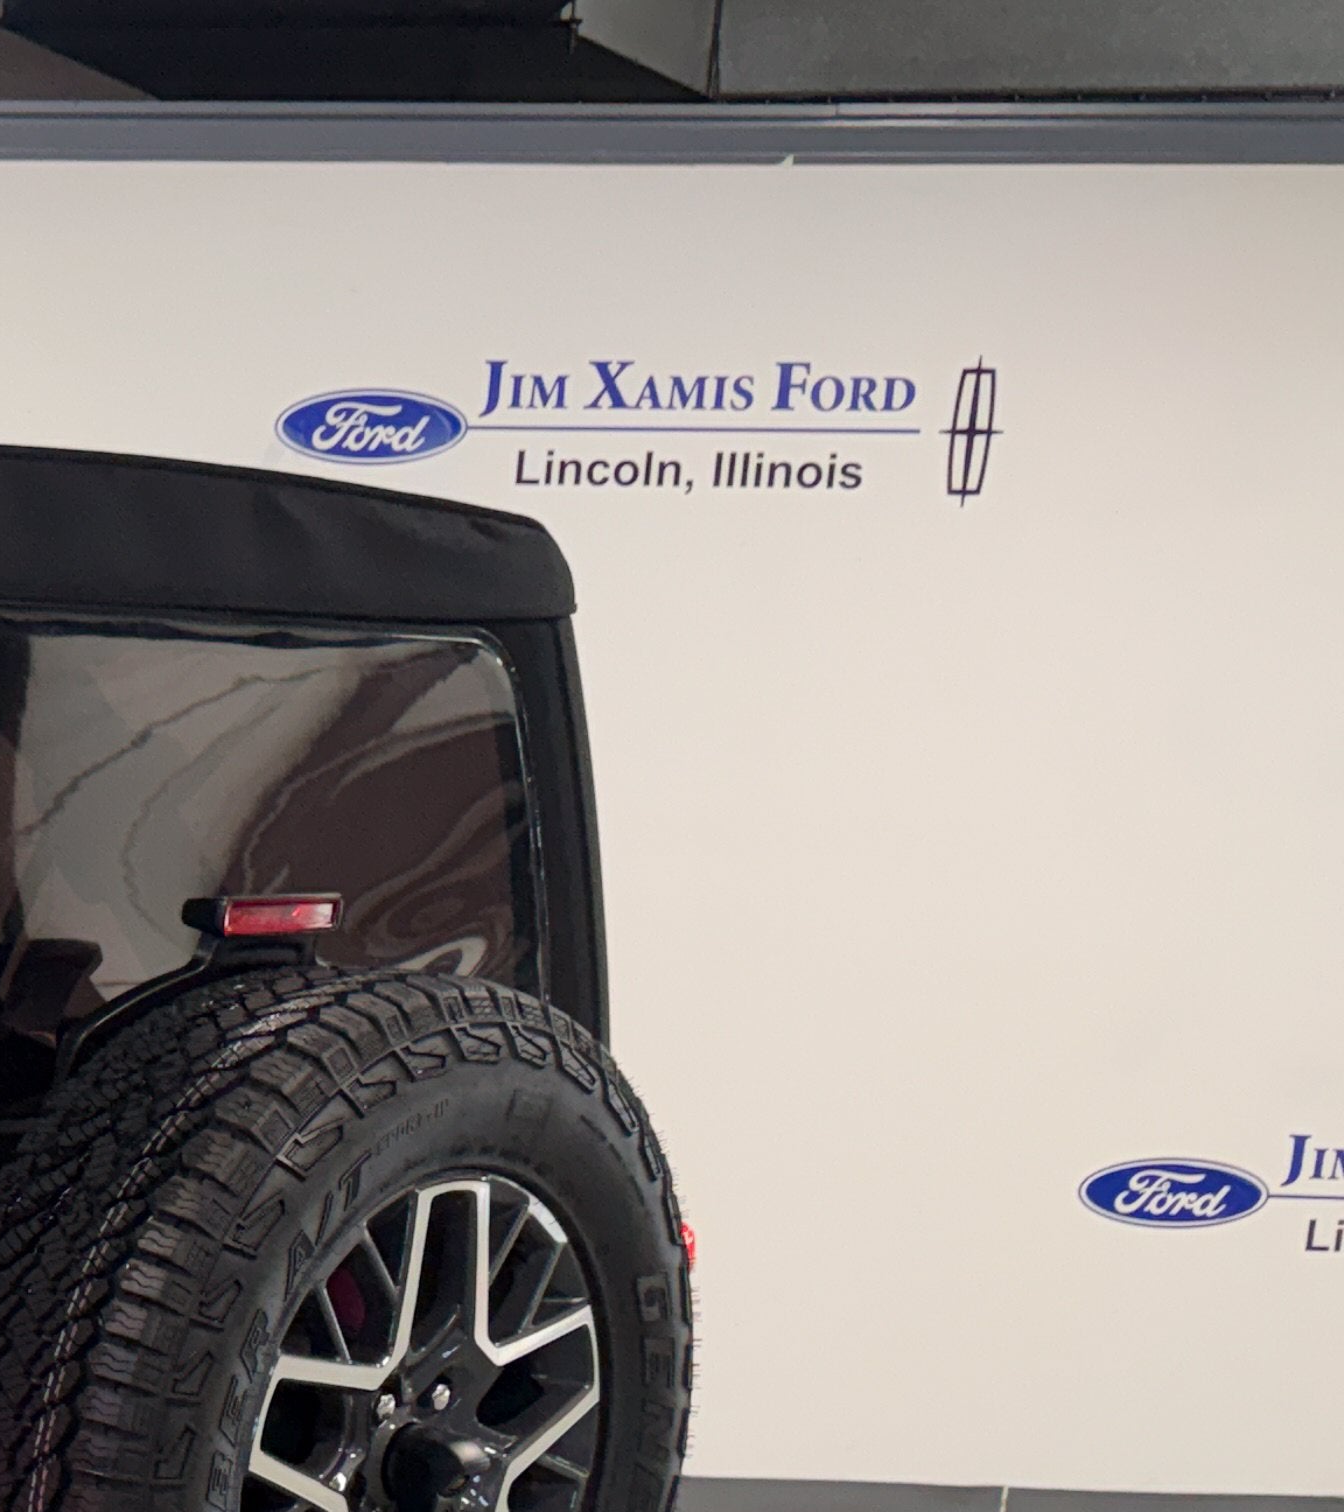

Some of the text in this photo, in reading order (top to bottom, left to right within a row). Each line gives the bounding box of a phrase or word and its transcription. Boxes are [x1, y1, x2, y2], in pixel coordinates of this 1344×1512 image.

[479, 359, 917, 418] JIM XAMIS FORD
[312, 402, 425, 453] Ford
[514, 449, 863, 495] Lincoln, Illinois
[1113, 1168, 1232, 1218] Ford
